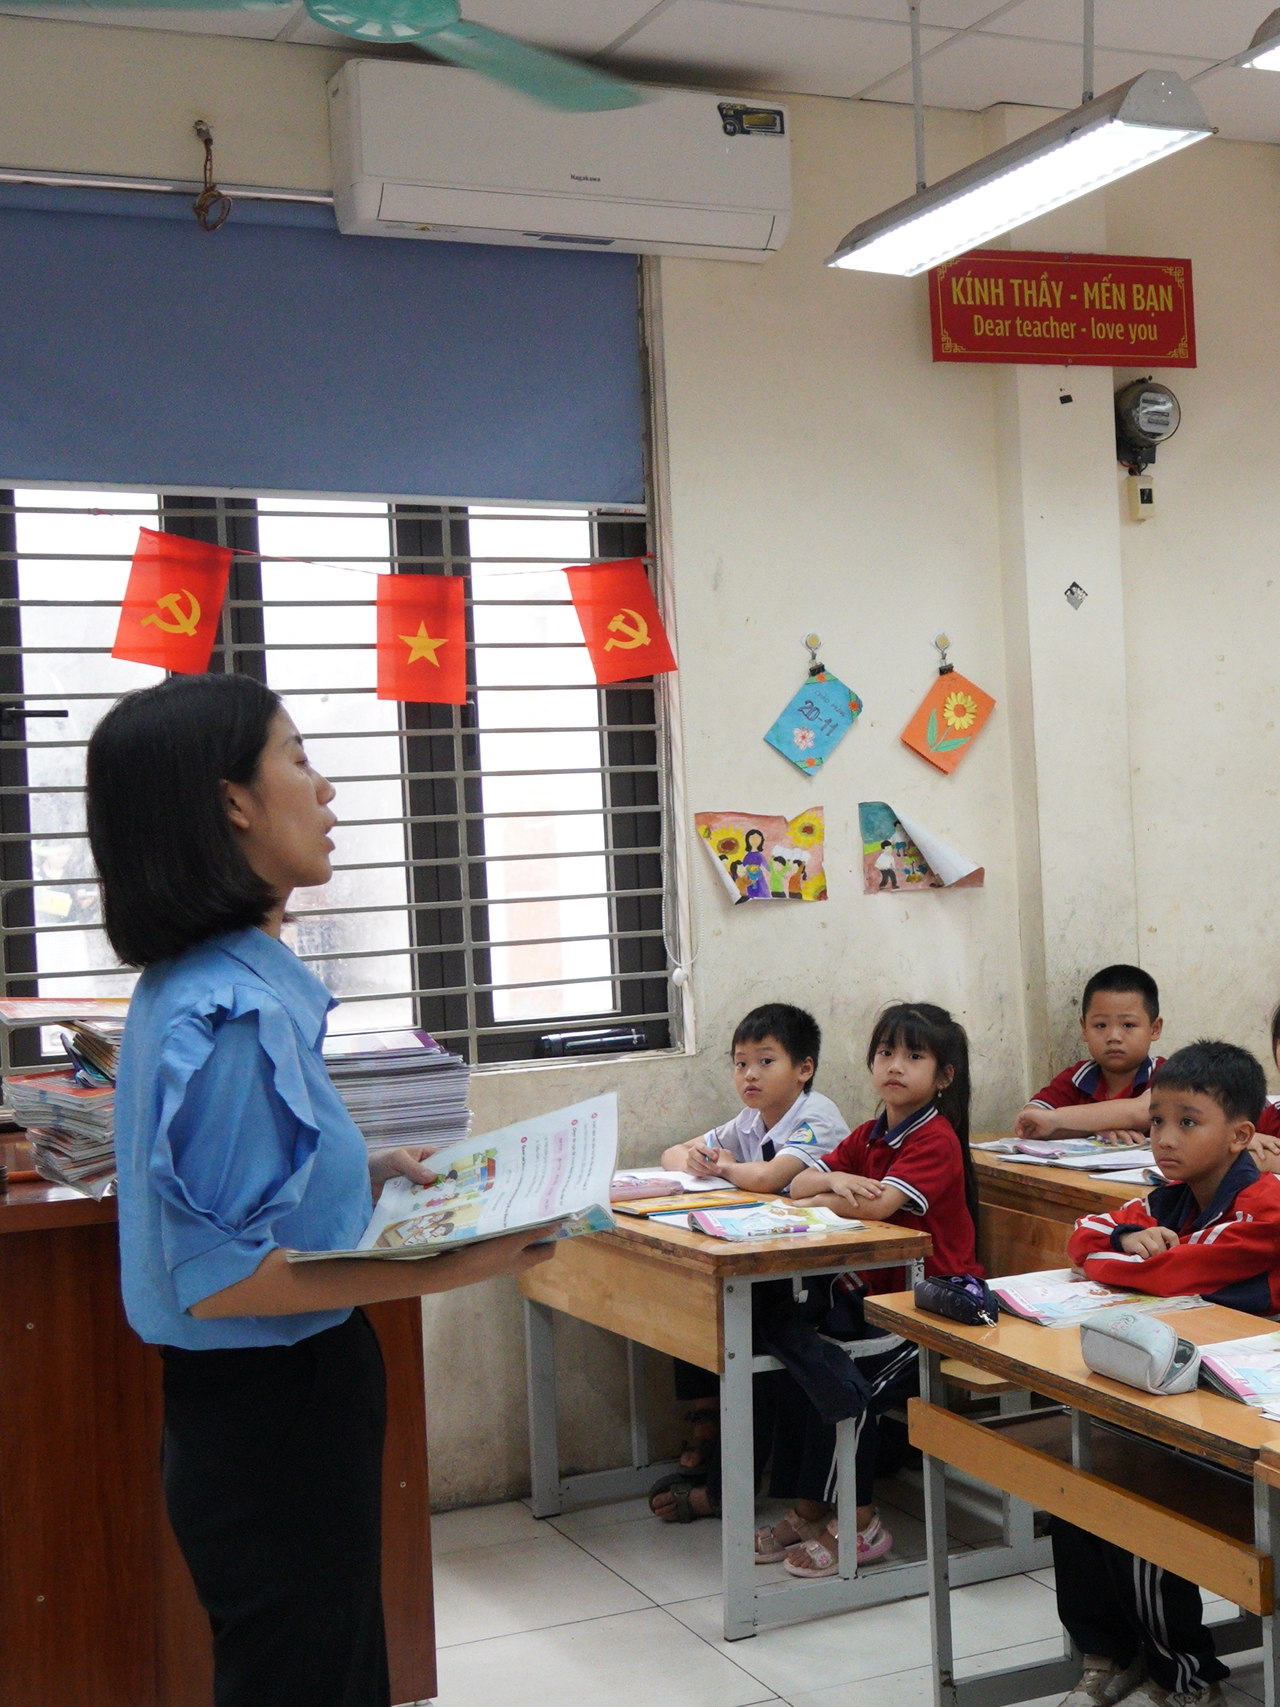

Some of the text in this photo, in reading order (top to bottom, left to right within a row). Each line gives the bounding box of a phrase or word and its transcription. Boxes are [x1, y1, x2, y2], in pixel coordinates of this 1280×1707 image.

[951, 270, 1005, 306] KÍNH
[1010, 271, 1063, 308] THẦY
[1083, 274, 1127, 310] MẾN
[1133, 284, 1173, 317] BẠN
[973, 314, 1011, 337] Dear
[1015, 316, 1077, 339] teacher
[1091, 317, 1125, 340] love
[1128, 323, 1158, 344] you
